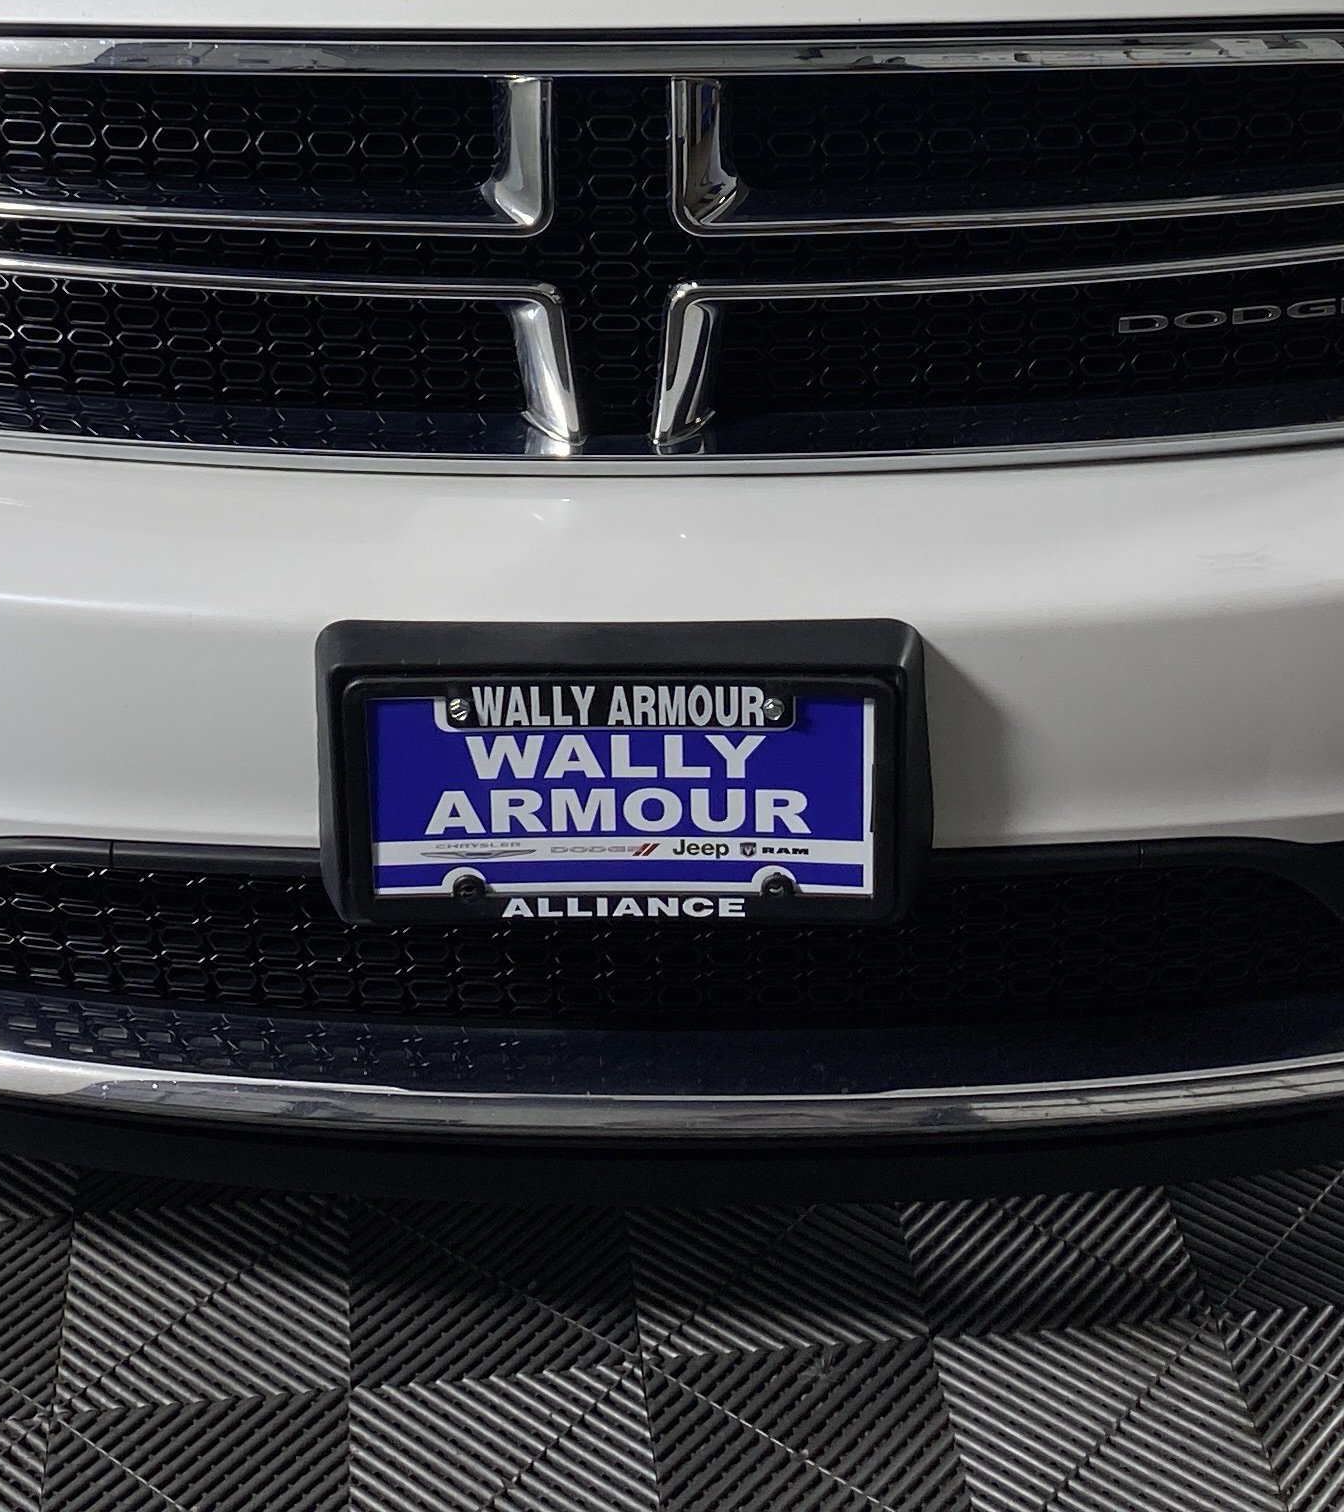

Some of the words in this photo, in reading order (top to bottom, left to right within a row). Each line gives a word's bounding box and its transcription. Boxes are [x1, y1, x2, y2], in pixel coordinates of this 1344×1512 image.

[471, 686, 595, 727] WALLY
[607, 684, 765, 727] ARMOUR
[465, 734, 767, 780] WALLY
[424, 788, 812, 836] ARMOUR
[435, 841, 521, 850] CHRYSLER
[550, 845, 641, 855] DODGE
[672, 839, 730, 859] Jeep
[762, 846, 809, 856] RAM
[502, 897, 747, 919] ALLIANCE
